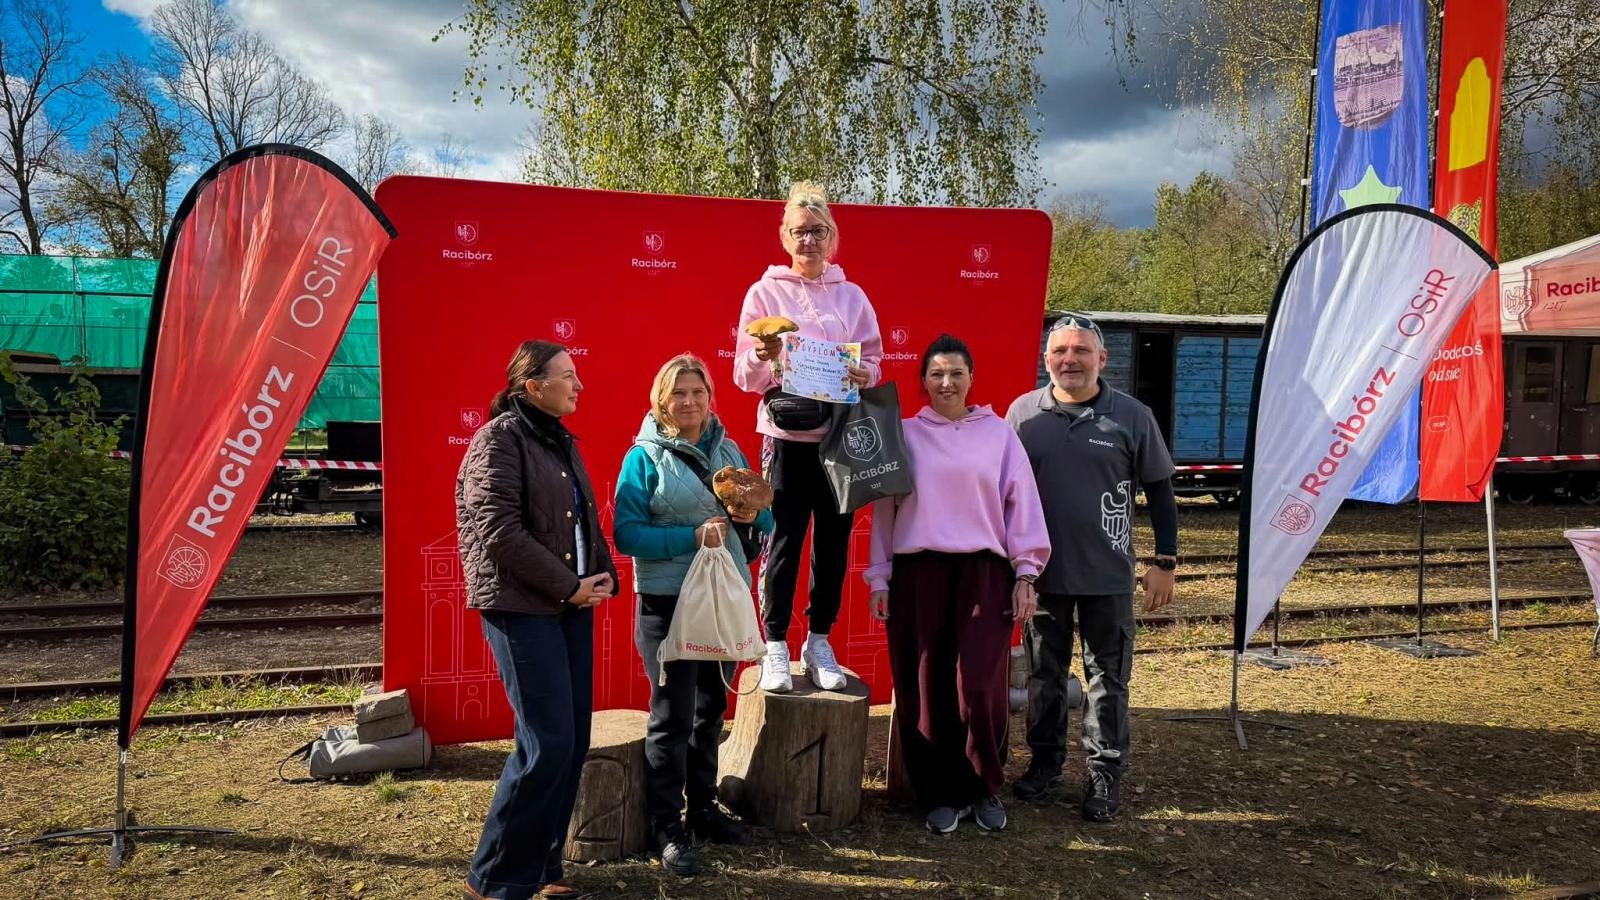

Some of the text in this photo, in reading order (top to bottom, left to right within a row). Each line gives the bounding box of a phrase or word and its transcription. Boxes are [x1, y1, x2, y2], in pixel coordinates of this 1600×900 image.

[442, 249, 493, 261] Racibórz
[631, 258, 677, 269] Racibórz
[960, 269, 999, 279] Racibórz
[187, 235, 353, 538] Racibórz OSiR
[1299, 268, 1456, 497] Racibórz OSiR
[843, 460, 900, 485] RACIBÓRZ
[685, 642, 729, 655] Racibórz
